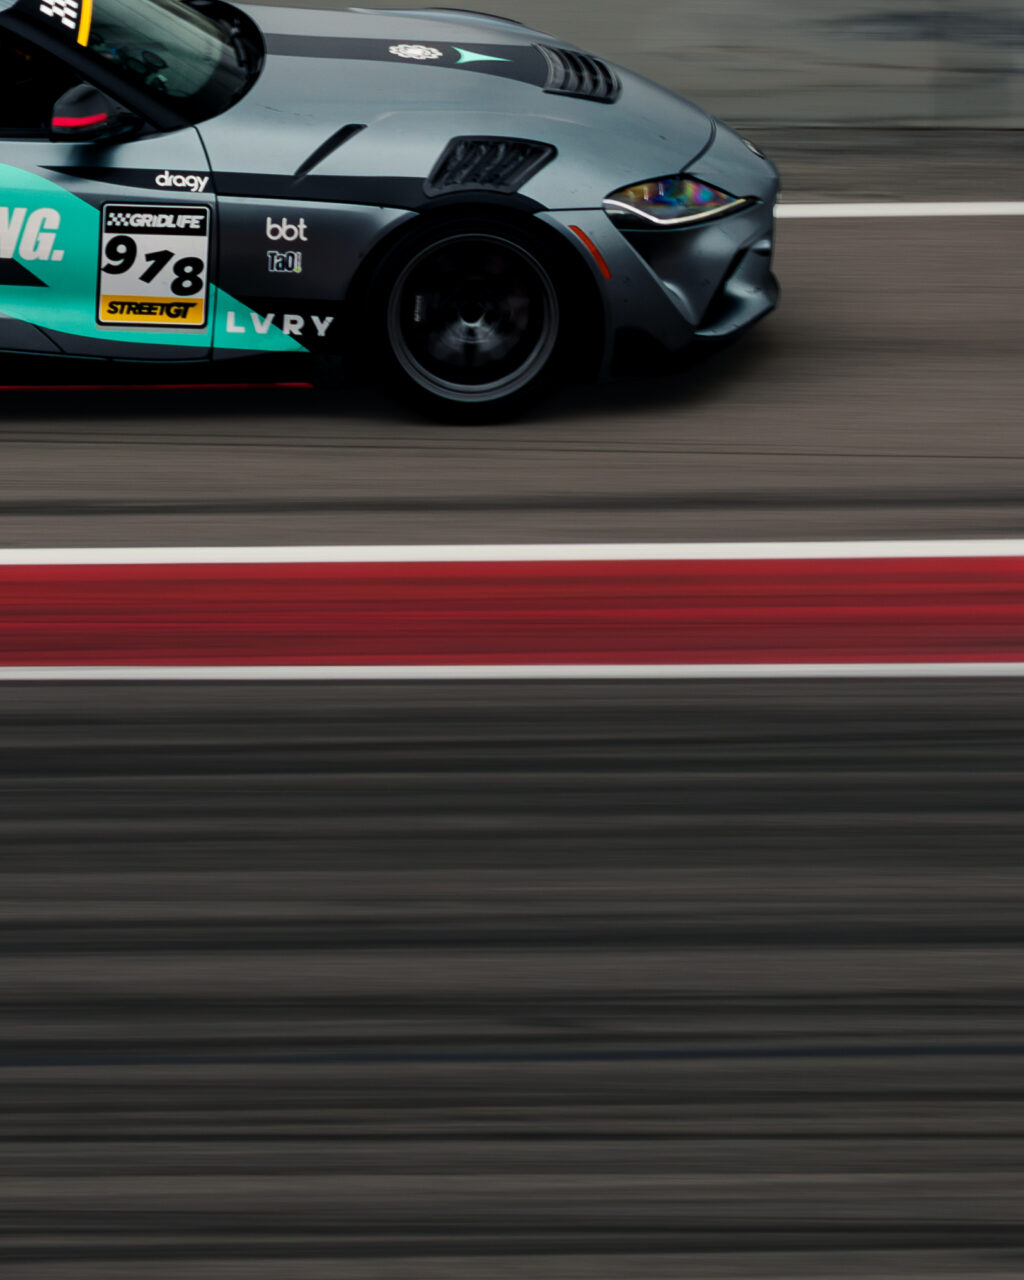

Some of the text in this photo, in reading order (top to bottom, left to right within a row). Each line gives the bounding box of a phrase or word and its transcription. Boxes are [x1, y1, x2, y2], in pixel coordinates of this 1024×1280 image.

[155, 170, 209, 192] dragy
[129, 214, 205, 229] GRIDLIFE
[266, 217, 308, 241] bbt
[101, 235, 204, 296] 918
[226, 311, 334, 337] LVRY
